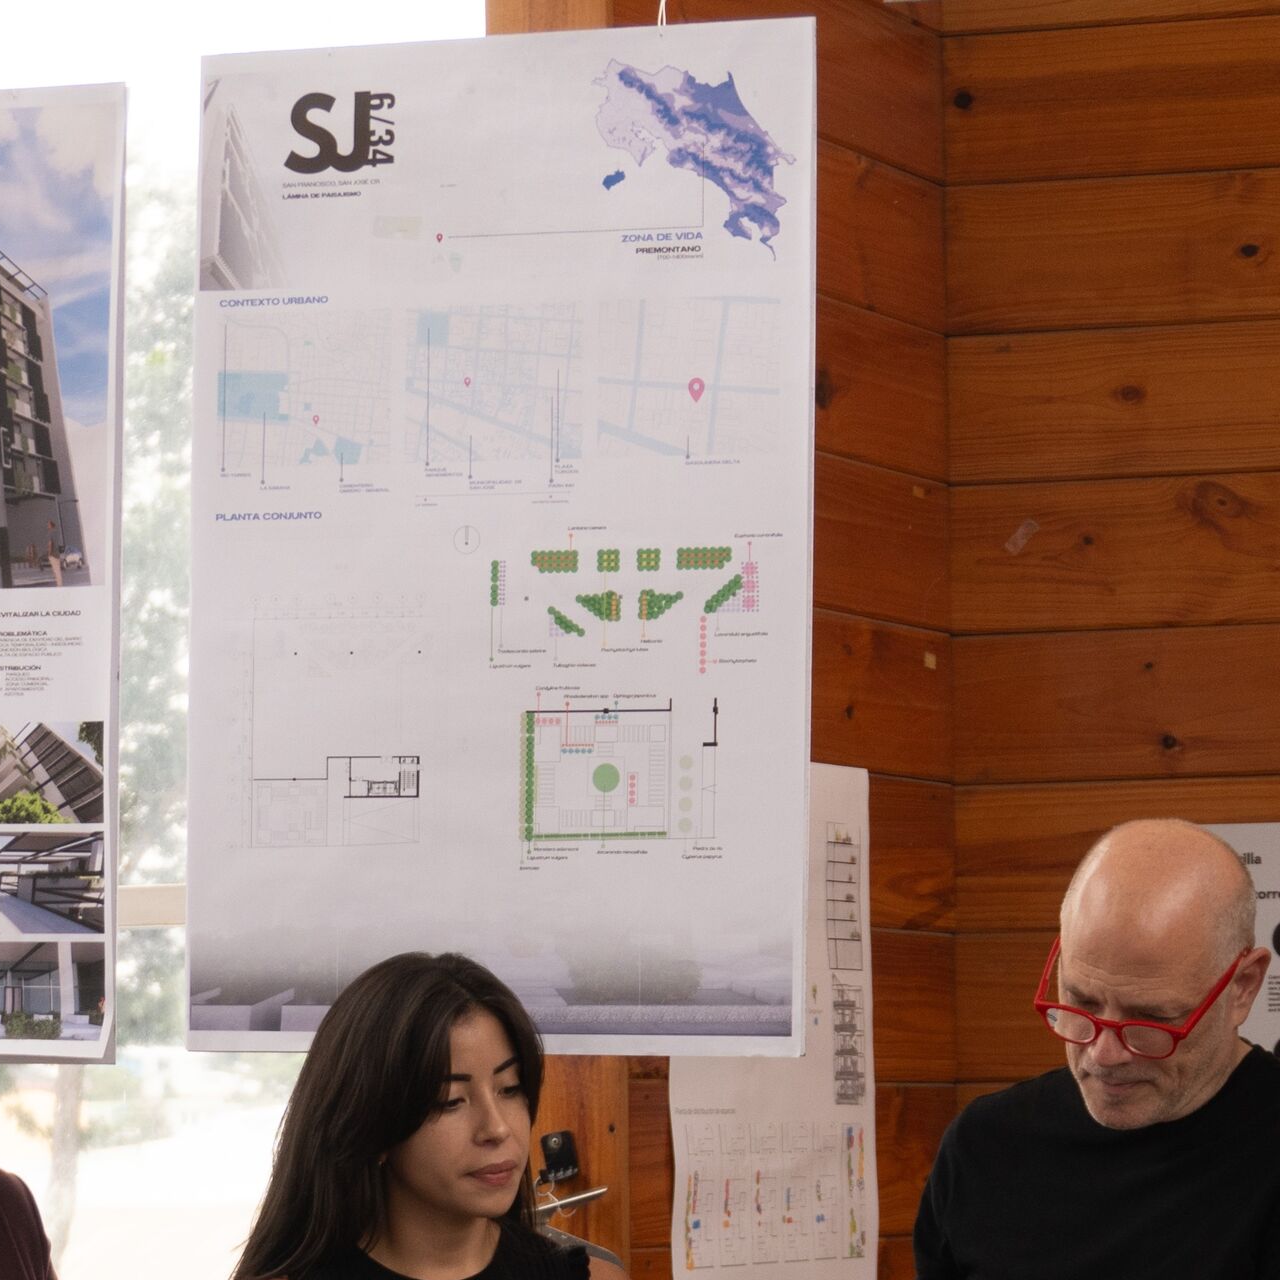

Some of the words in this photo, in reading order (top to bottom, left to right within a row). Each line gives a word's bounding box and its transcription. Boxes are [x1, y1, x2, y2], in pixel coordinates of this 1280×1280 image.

[284, 91, 371, 174] SJ
[622, 233, 654, 243] ZONA
[656, 232, 673, 241] DE
[675, 231, 703, 241] VIDA
[635, 245, 701, 254] PREMONTANO
[219, 297, 281, 308] CONTEXTO
[282, 295, 329, 305] URBANO
[215, 512, 260, 522] PLANTA
[262, 511, 323, 521] CONJUNTO
